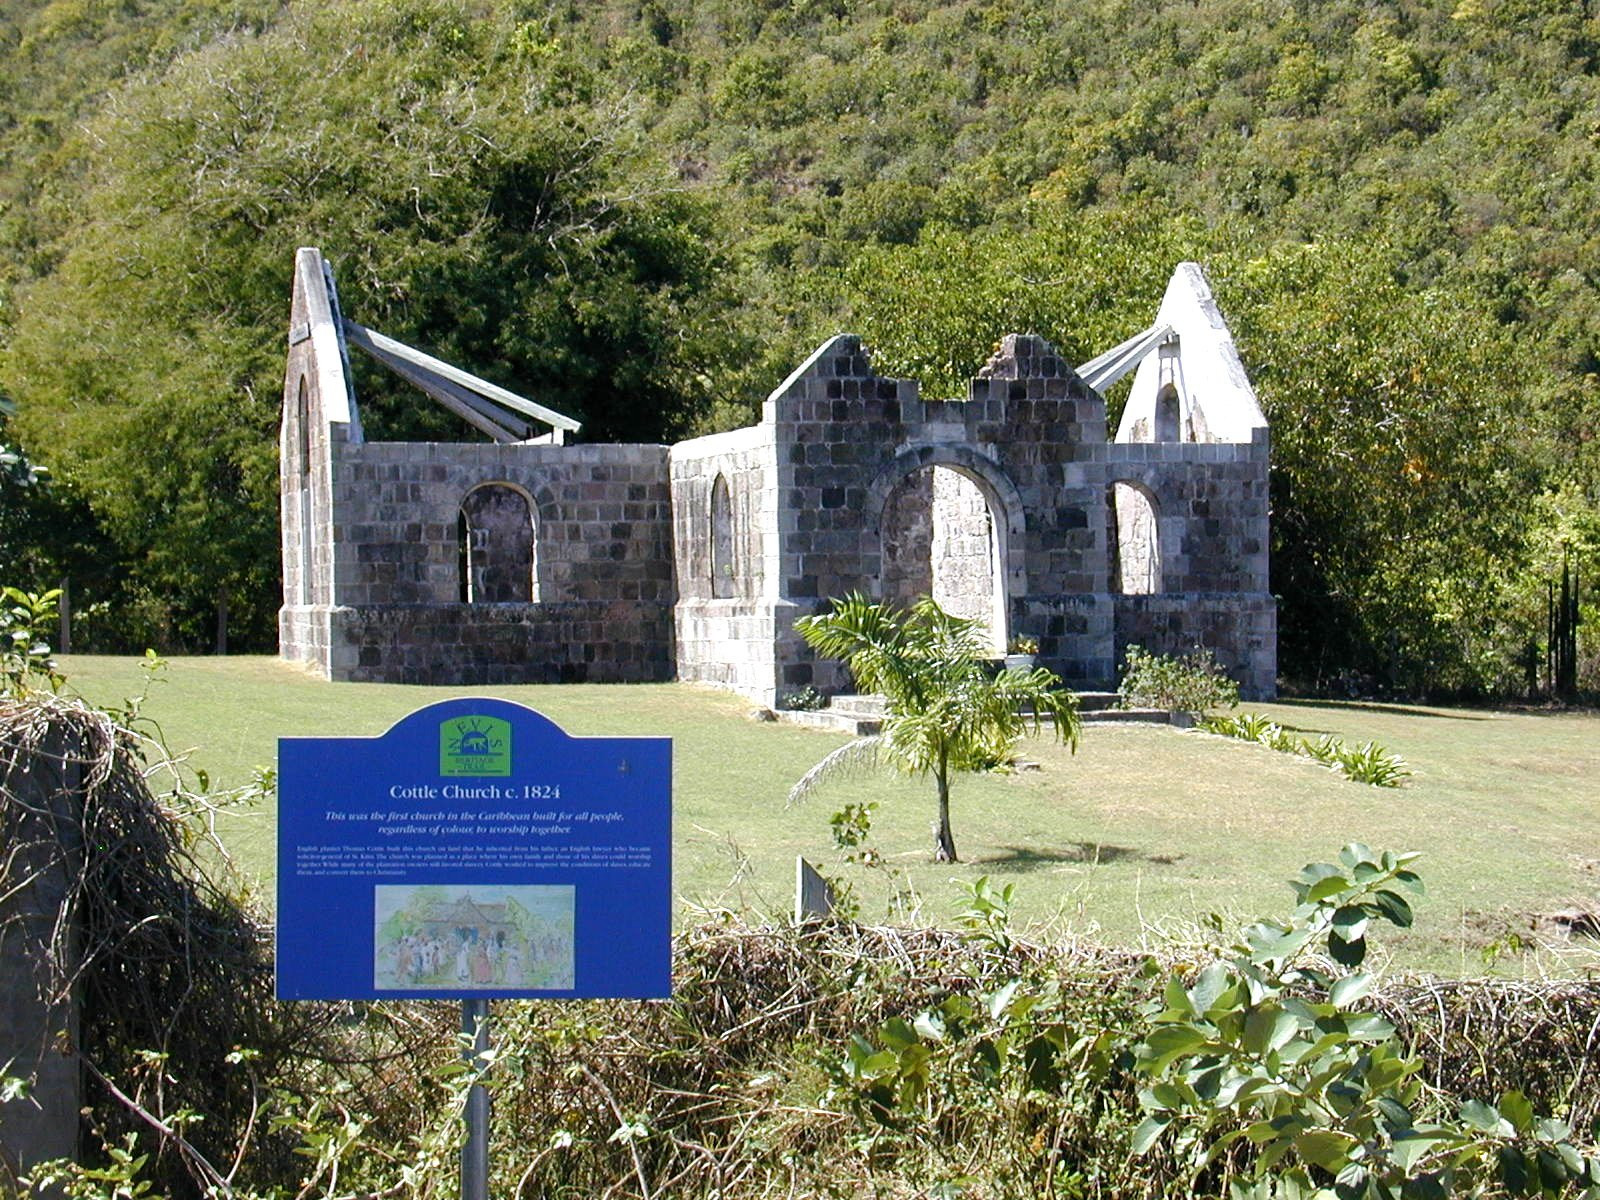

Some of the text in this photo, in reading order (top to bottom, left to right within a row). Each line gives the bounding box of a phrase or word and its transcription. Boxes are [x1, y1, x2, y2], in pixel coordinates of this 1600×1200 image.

[389, 784, 561, 799] Cottle Church c. 1824
[326, 811, 625, 823] This was the first church in the Caribbean built for all people,
[378, 825, 426, 836] regardless
[427, 825, 441, 837] of
[476, 825, 487, 835] to
[488, 825, 529, 837] worship
